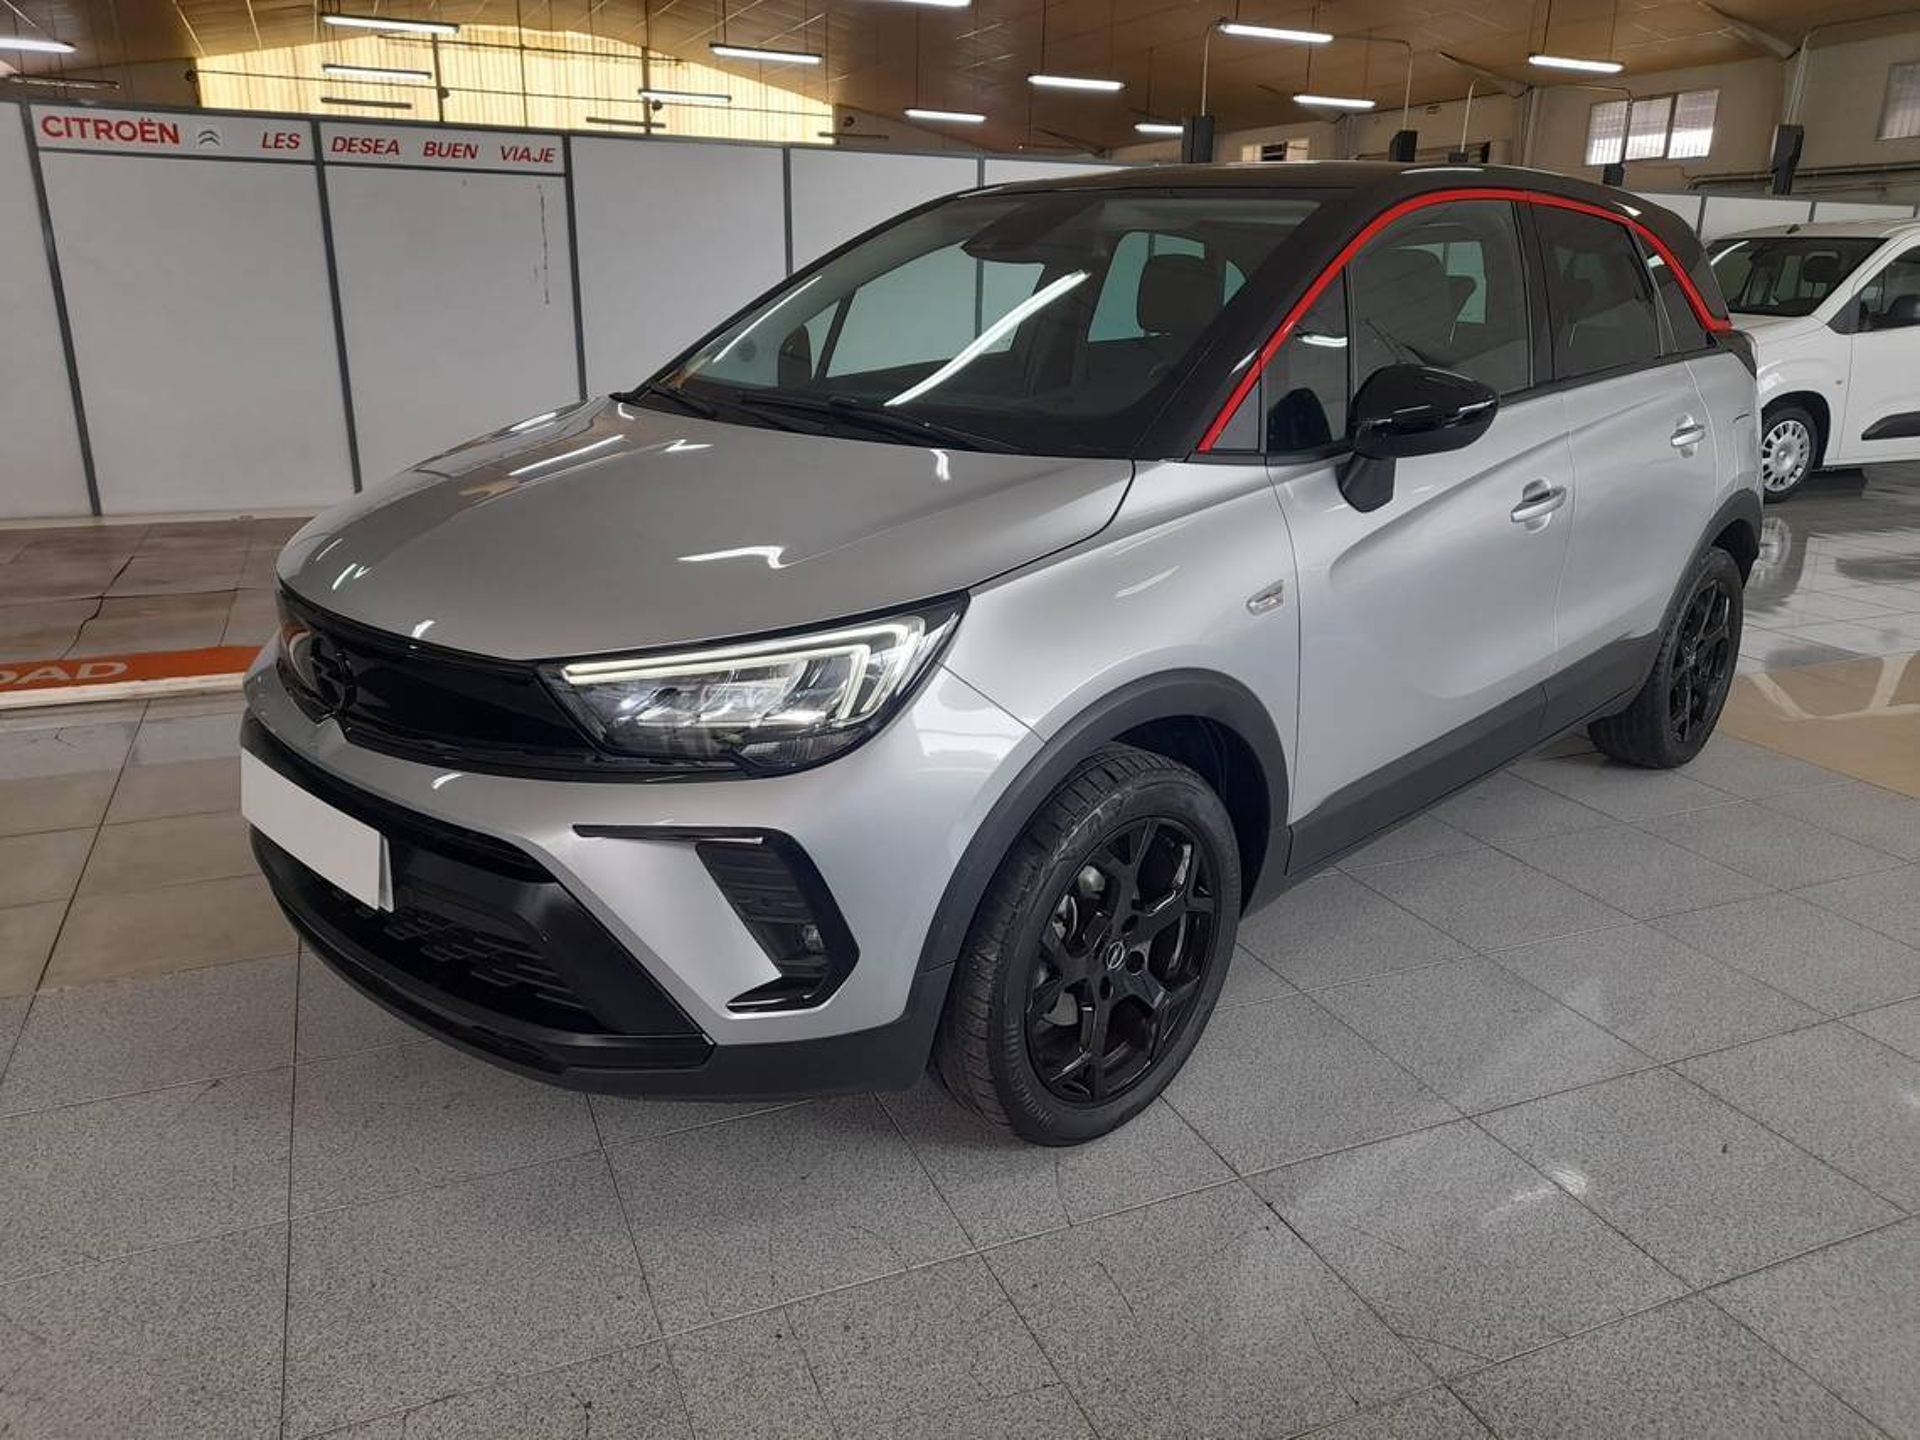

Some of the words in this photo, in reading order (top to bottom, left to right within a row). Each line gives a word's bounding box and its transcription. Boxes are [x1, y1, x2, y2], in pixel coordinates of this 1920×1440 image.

[40, 114, 181, 146] CITROËN
[261, 132, 301, 151] LES
[331, 137, 400, 156] DESEA
[423, 141, 479, 160] BUEN
[499, 145, 556, 164] VIAJE
